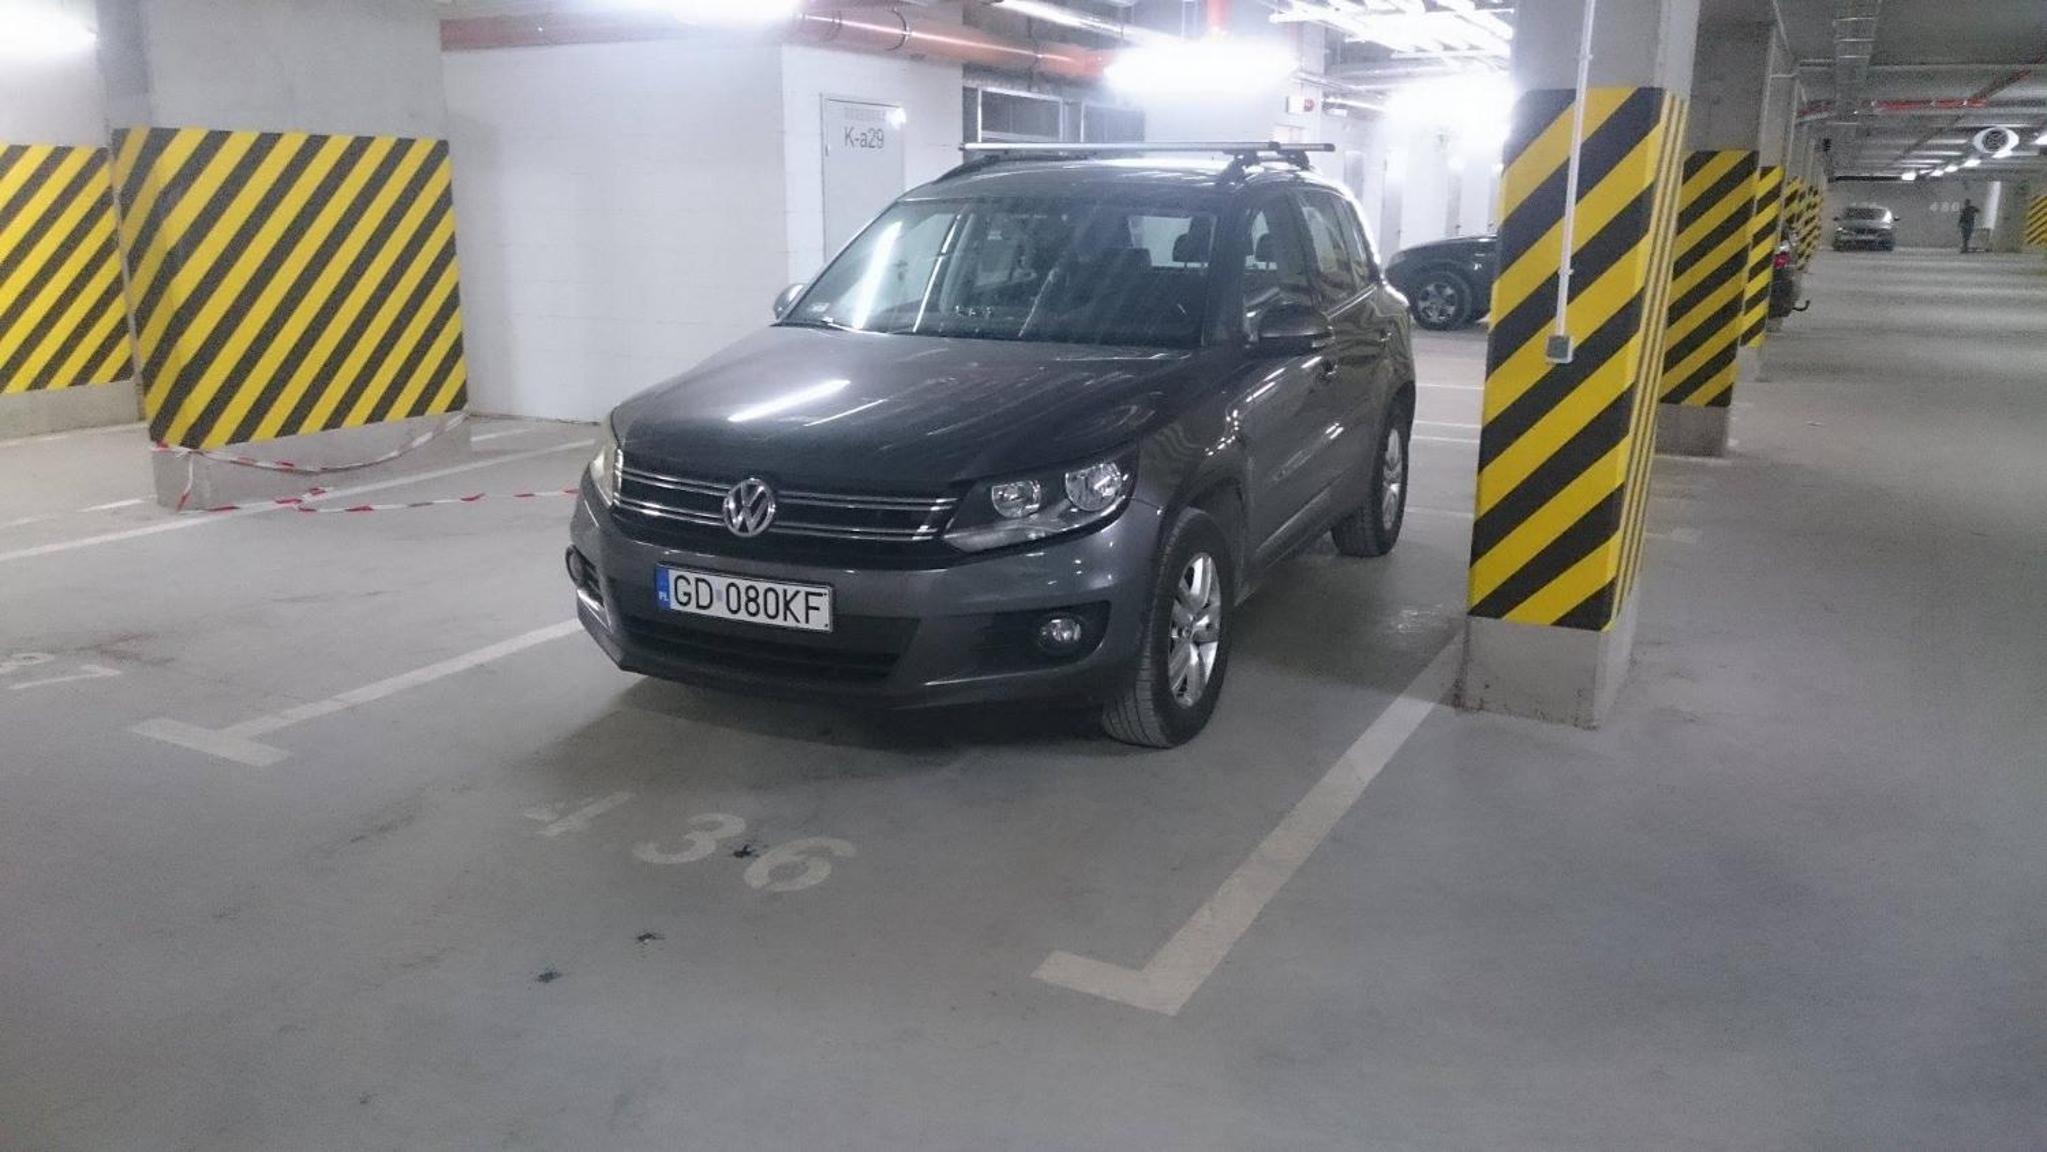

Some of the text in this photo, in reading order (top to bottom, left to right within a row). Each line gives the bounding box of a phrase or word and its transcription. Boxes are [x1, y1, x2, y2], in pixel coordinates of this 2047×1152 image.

[843, 125, 885, 149] K-a29
[674, 575, 824, 625] GD 080KF
[523, 790, 857, 892] 136
